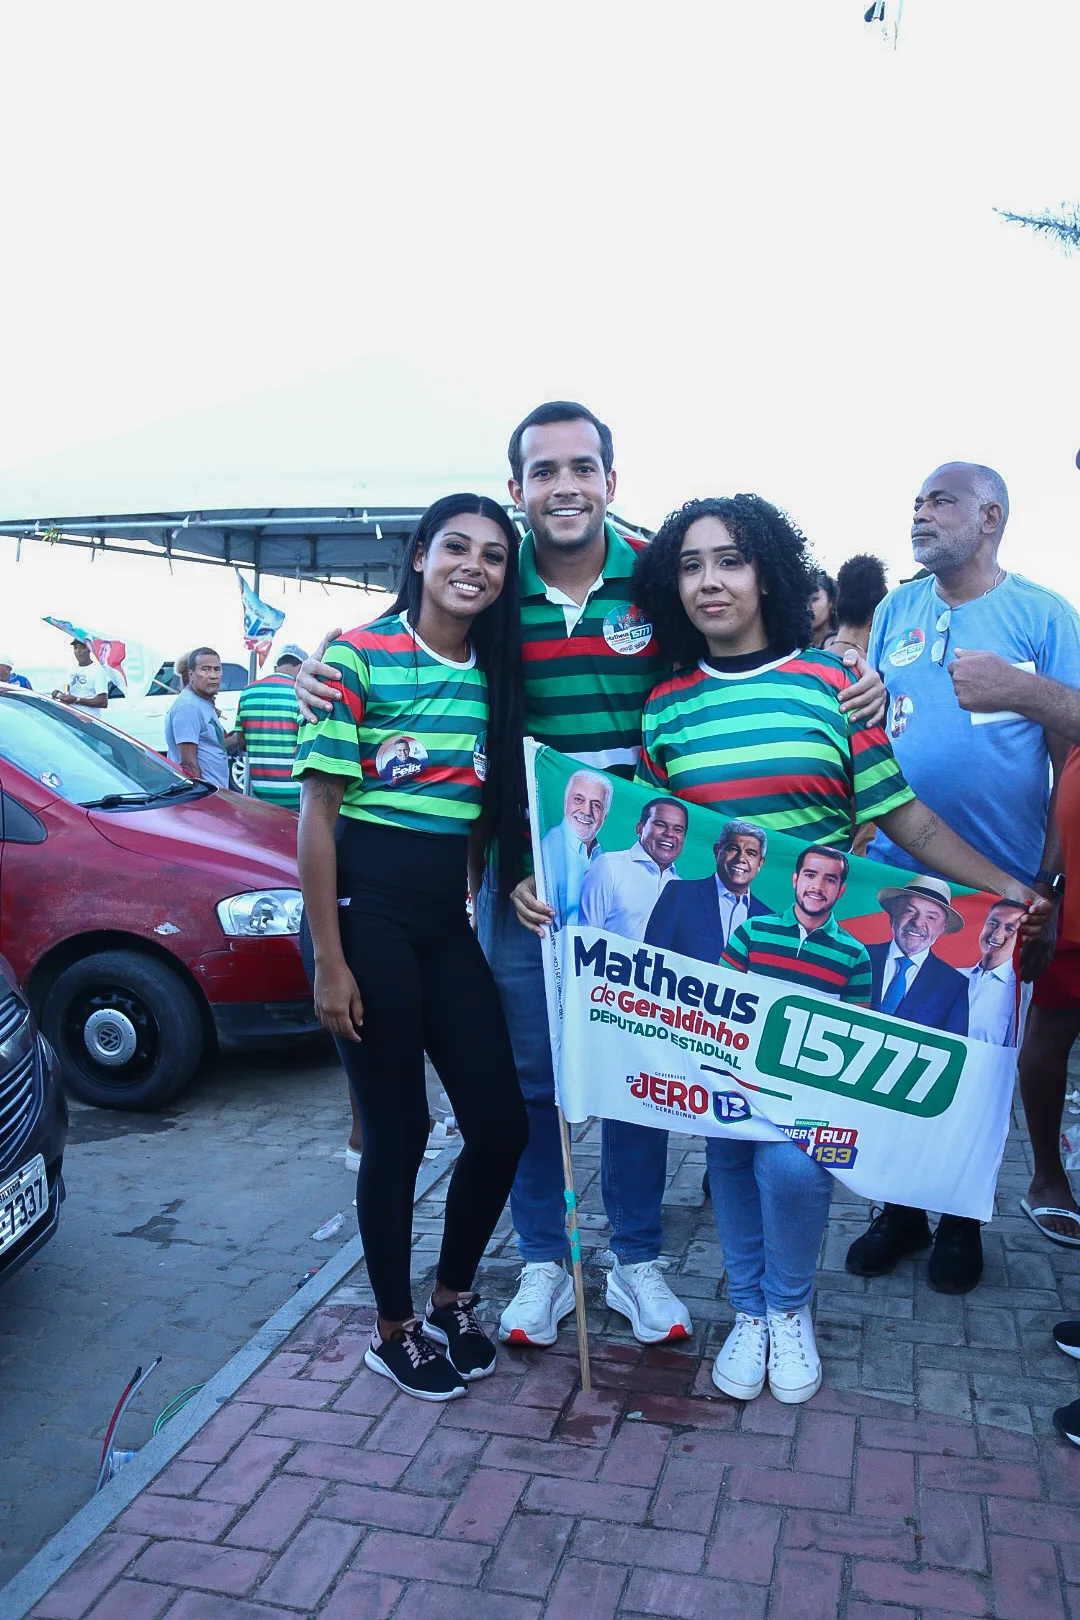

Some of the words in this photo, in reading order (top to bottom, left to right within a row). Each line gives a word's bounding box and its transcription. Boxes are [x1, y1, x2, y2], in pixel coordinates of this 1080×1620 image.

[573, 935, 760, 1025] Matheus
[589, 1008, 669, 1040] DEPUTADO
[670, 1032, 742, 1071] ESTADUAL
[590, 983, 615, 1006] de
[618, 990, 750, 1051] Geraldinho
[779, 1005, 952, 1104] 15777
[630, 1071, 709, 1115] JERO
[717, 1095, 747, 1118] 13
[655, 1105, 697, 1120] GERALDINHO
[815, 1146, 852, 1164] 133
[819, 1129, 853, 1144] RUI
